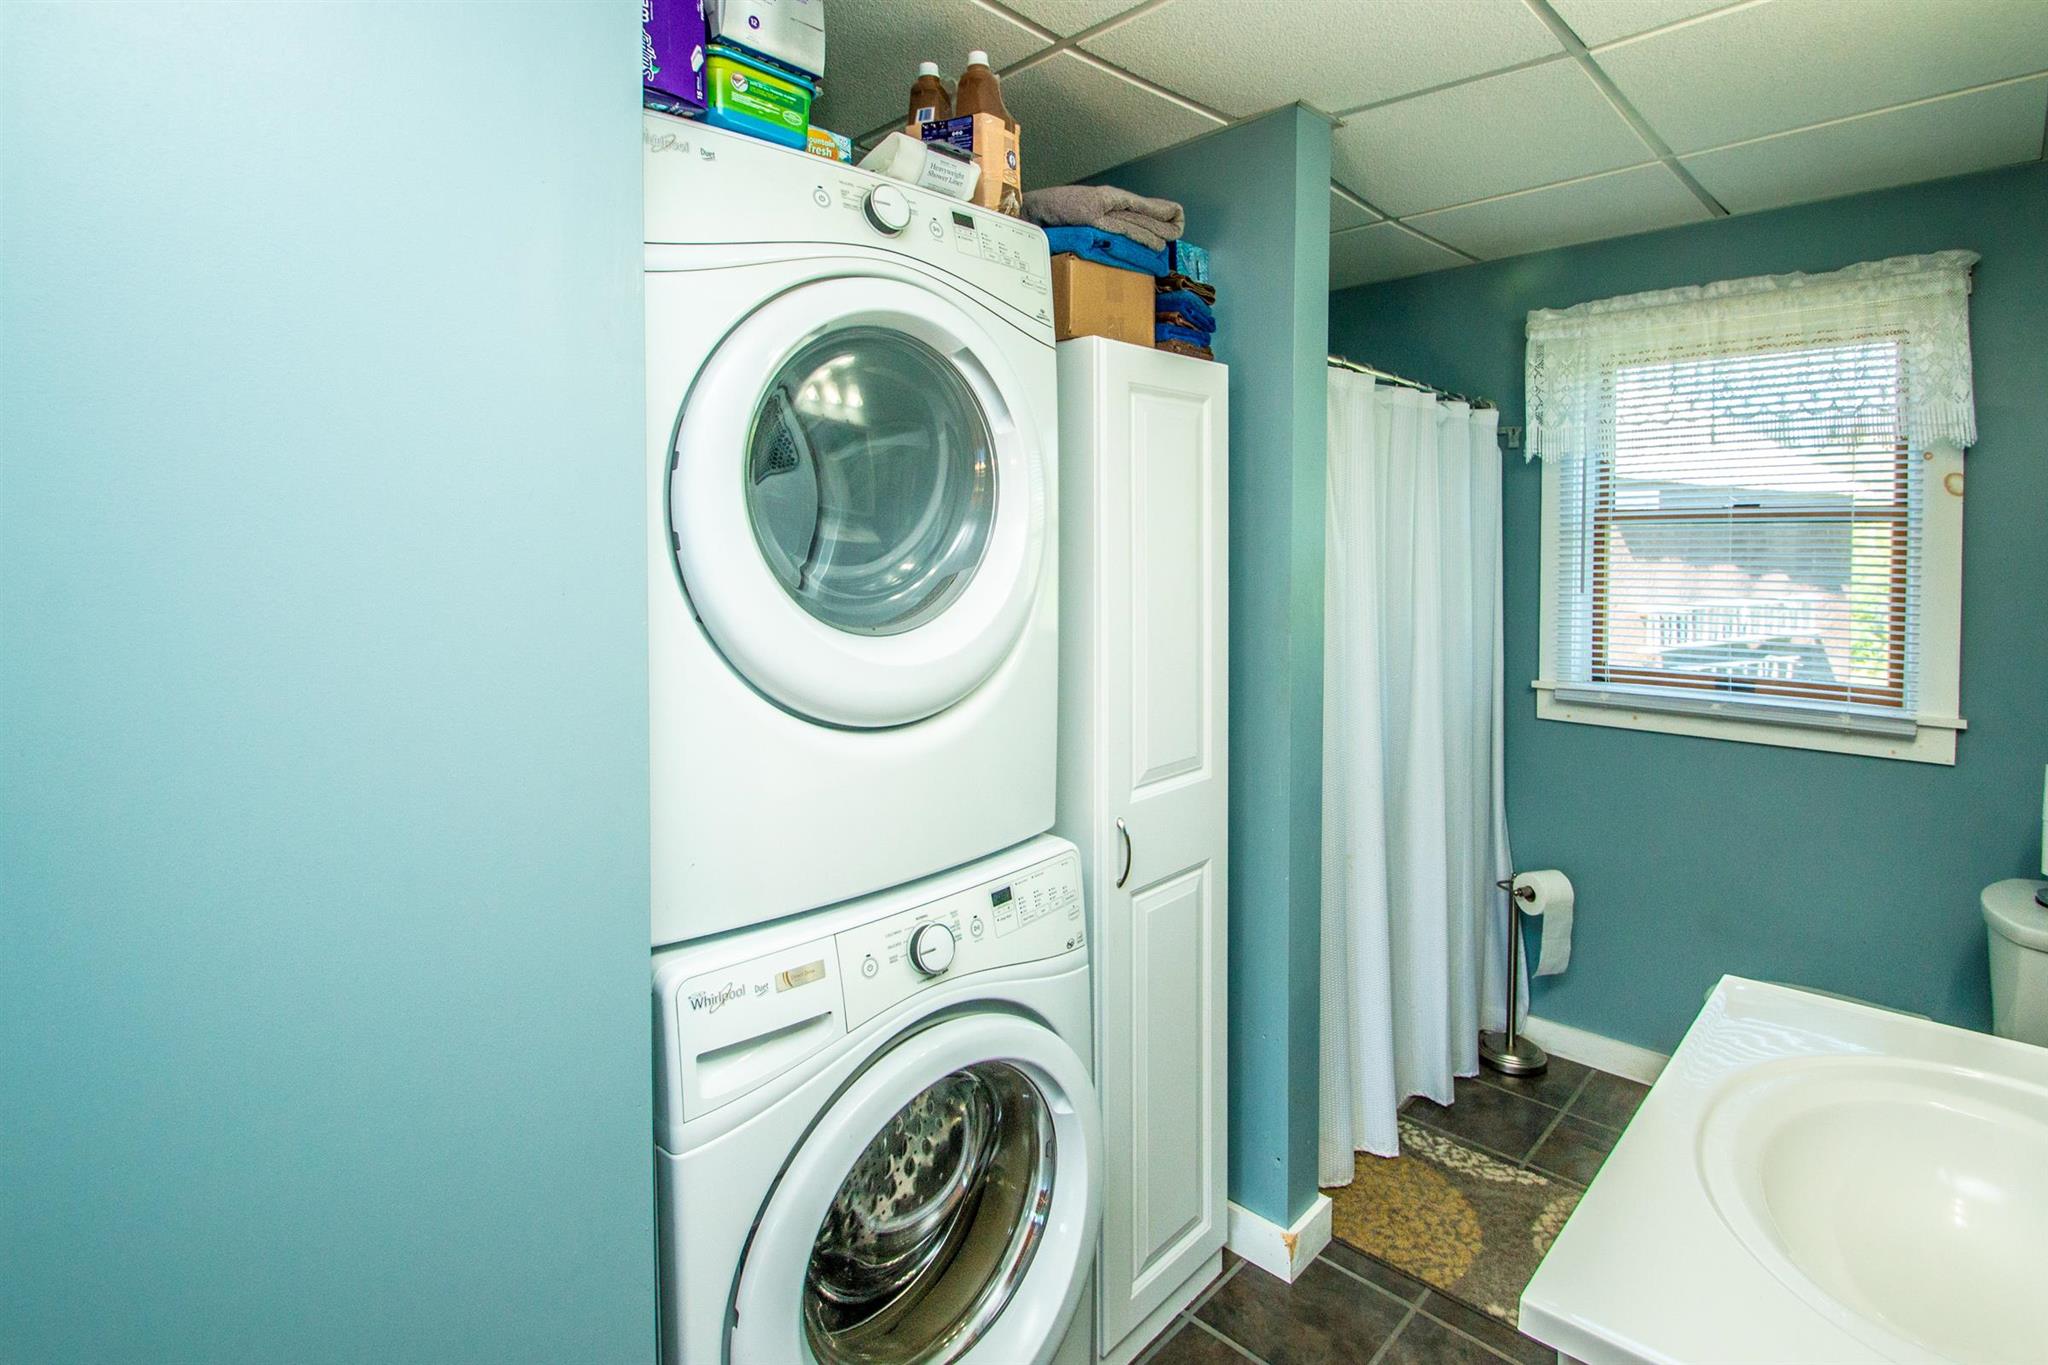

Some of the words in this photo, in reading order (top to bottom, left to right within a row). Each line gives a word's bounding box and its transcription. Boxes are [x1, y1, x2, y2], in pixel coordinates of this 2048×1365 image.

[808, 137, 835, 149] ountain
[808, 143, 833, 158] fresh
[927, 170, 949, 183] Shower
[948, 177, 964, 187] Liner
[930, 162, 965, 180] Heavyweight
[690, 983, 747, 1012] Whirlpool
[754, 982, 769, 995] Duet
